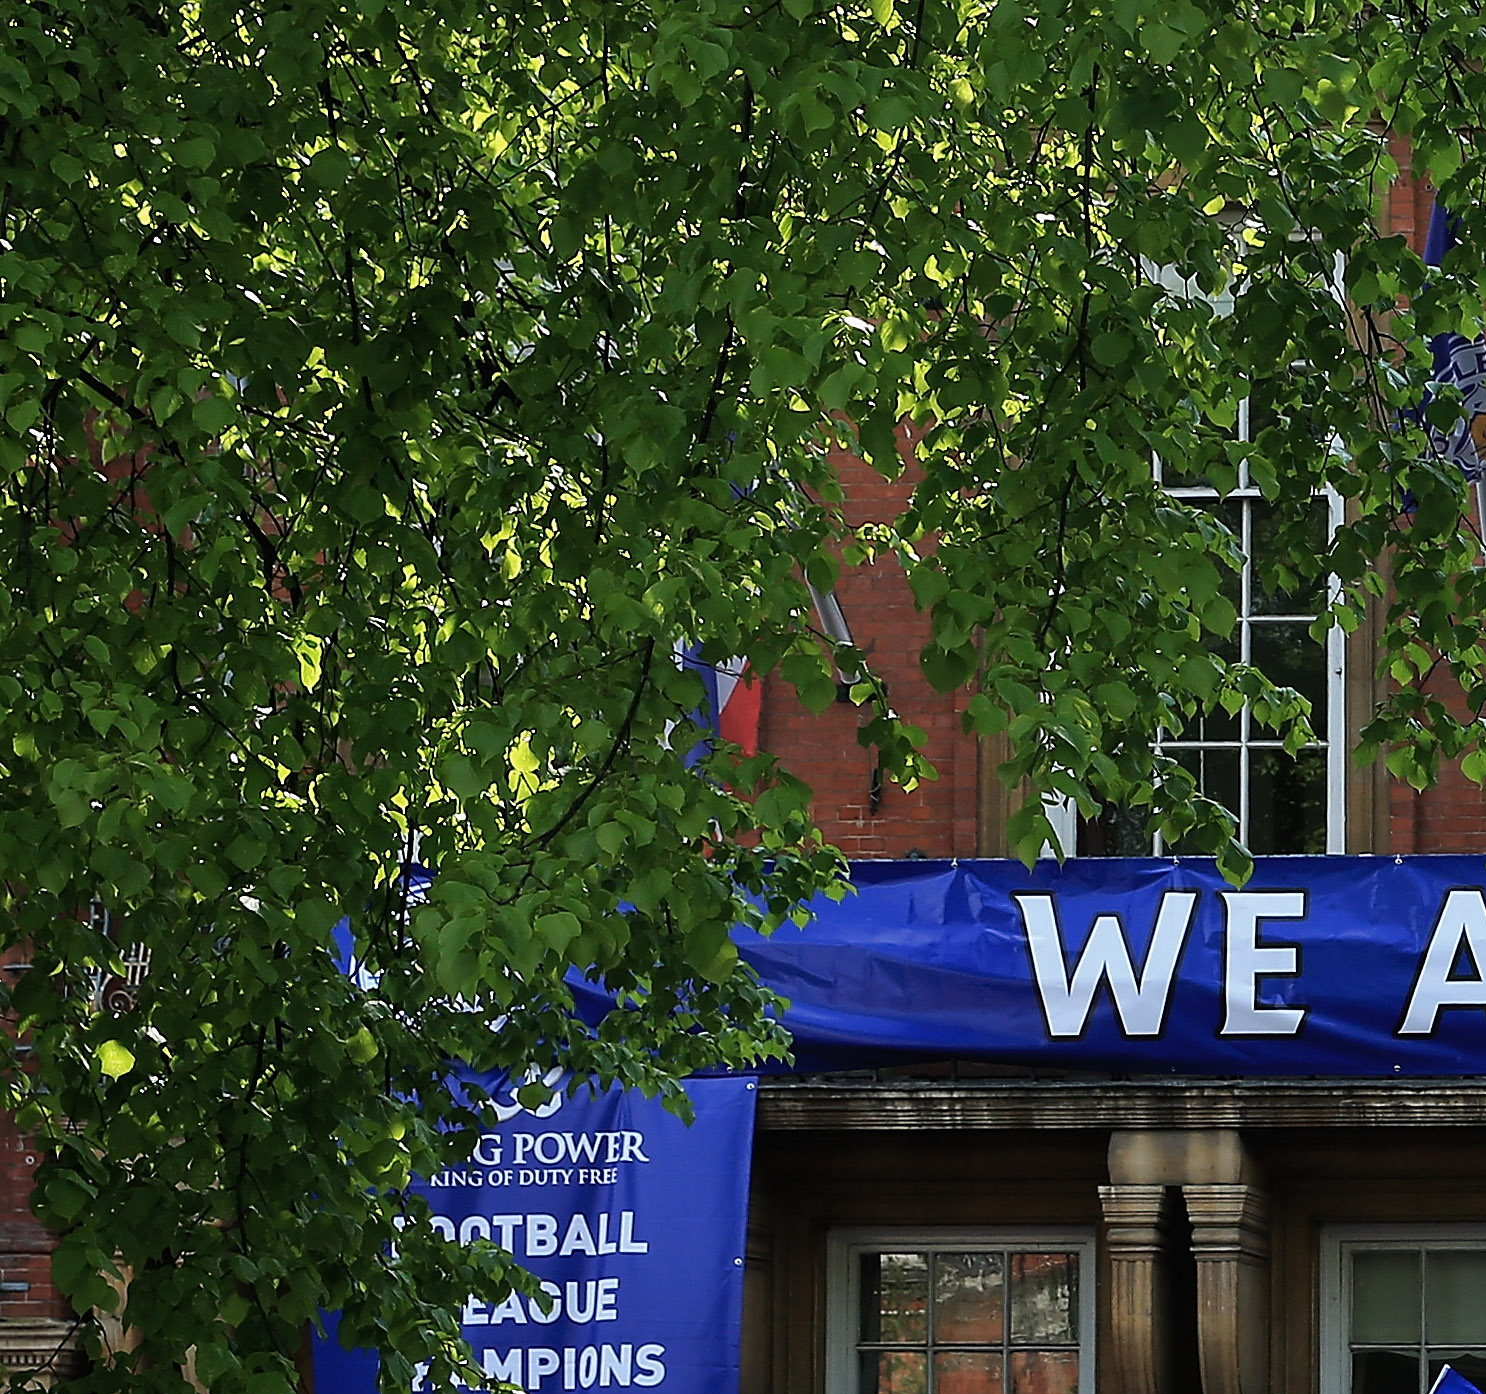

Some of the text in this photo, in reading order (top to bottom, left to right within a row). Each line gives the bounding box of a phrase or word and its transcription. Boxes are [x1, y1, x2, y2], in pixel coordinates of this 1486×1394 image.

[1012, 886, 1310, 1038] WE
[513, 1130, 649, 1165] POWER
[488, 1168, 513, 1187] OF
[519, 1168, 574, 1186] DUTY
[579, 1167, 619, 1185] FREE
[462, 1278, 619, 1325] EAGUE
